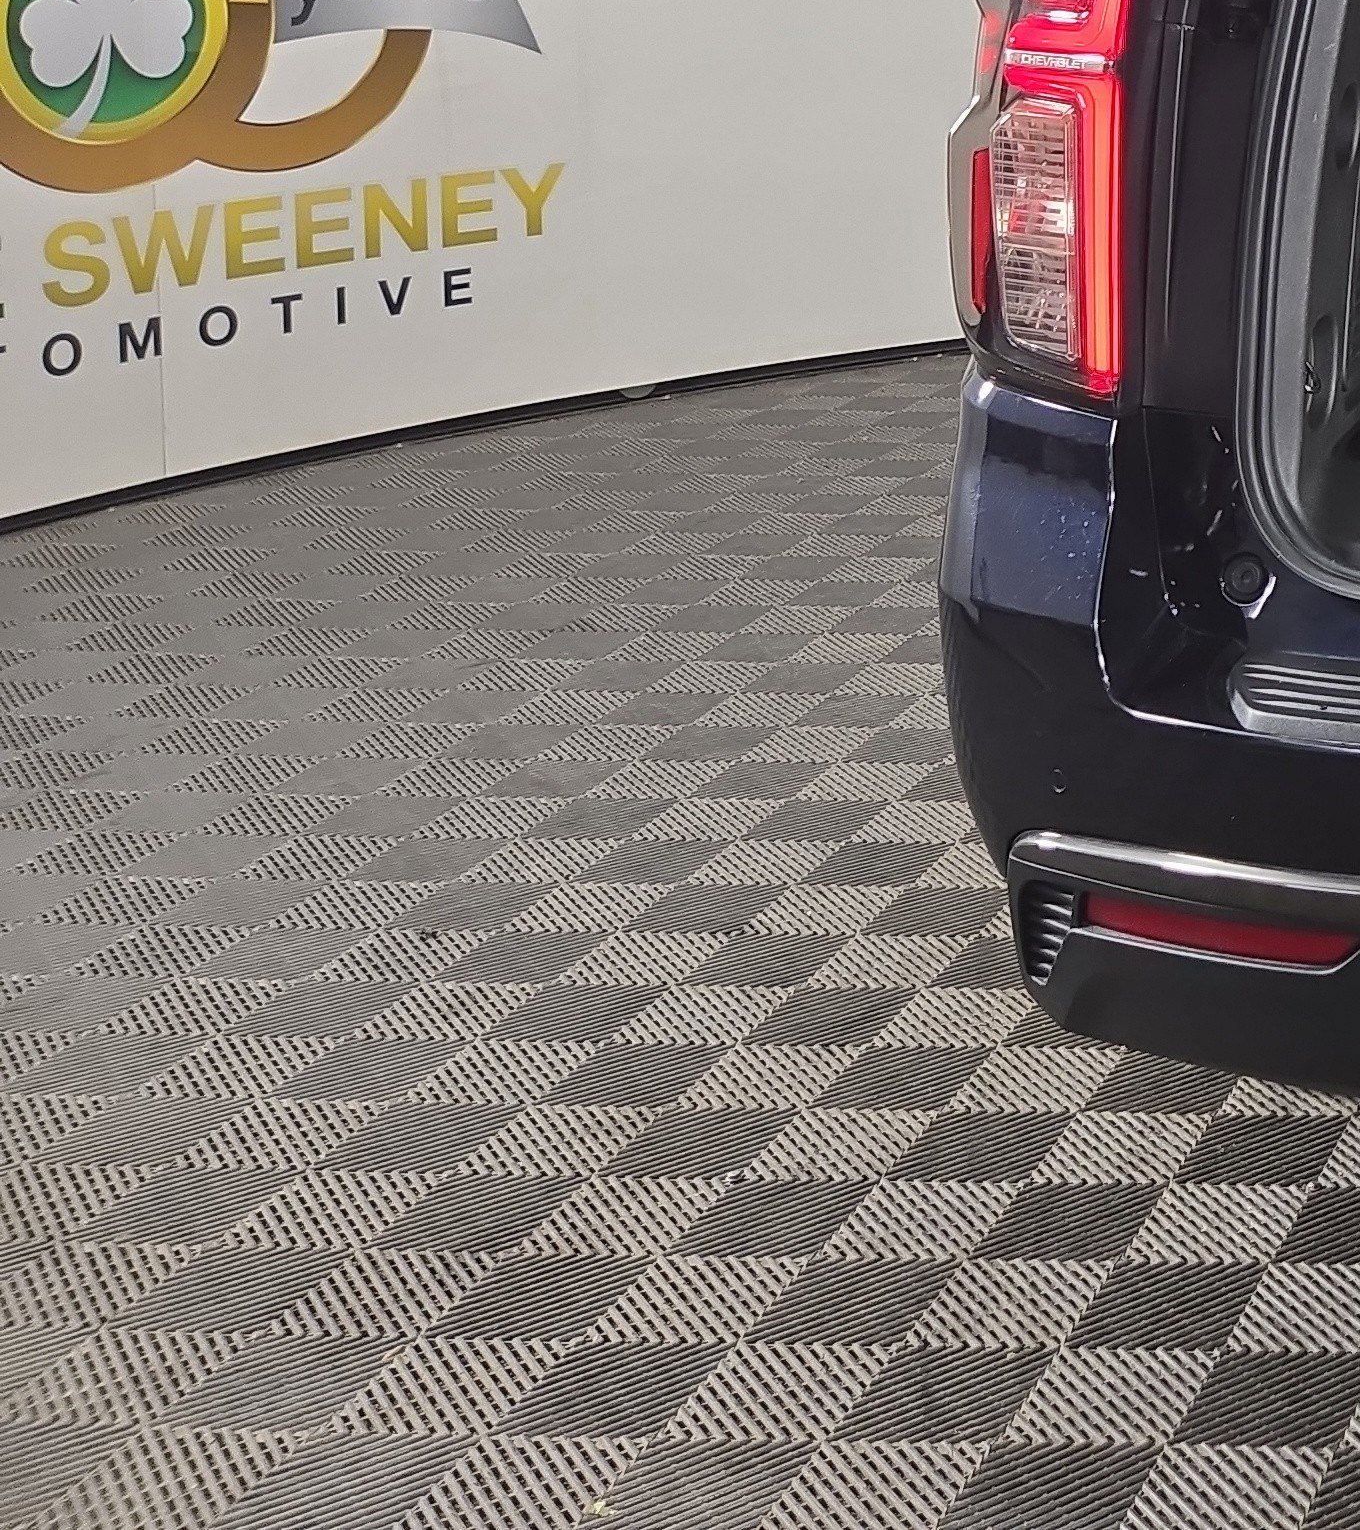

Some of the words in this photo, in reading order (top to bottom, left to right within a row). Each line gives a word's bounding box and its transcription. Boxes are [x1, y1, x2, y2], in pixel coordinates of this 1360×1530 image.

[1021, 53, 1087, 69] CHEVROLET
[41, 162, 566, 309] SWEENEY
[0, 267, 473, 377] OMOTIVE
